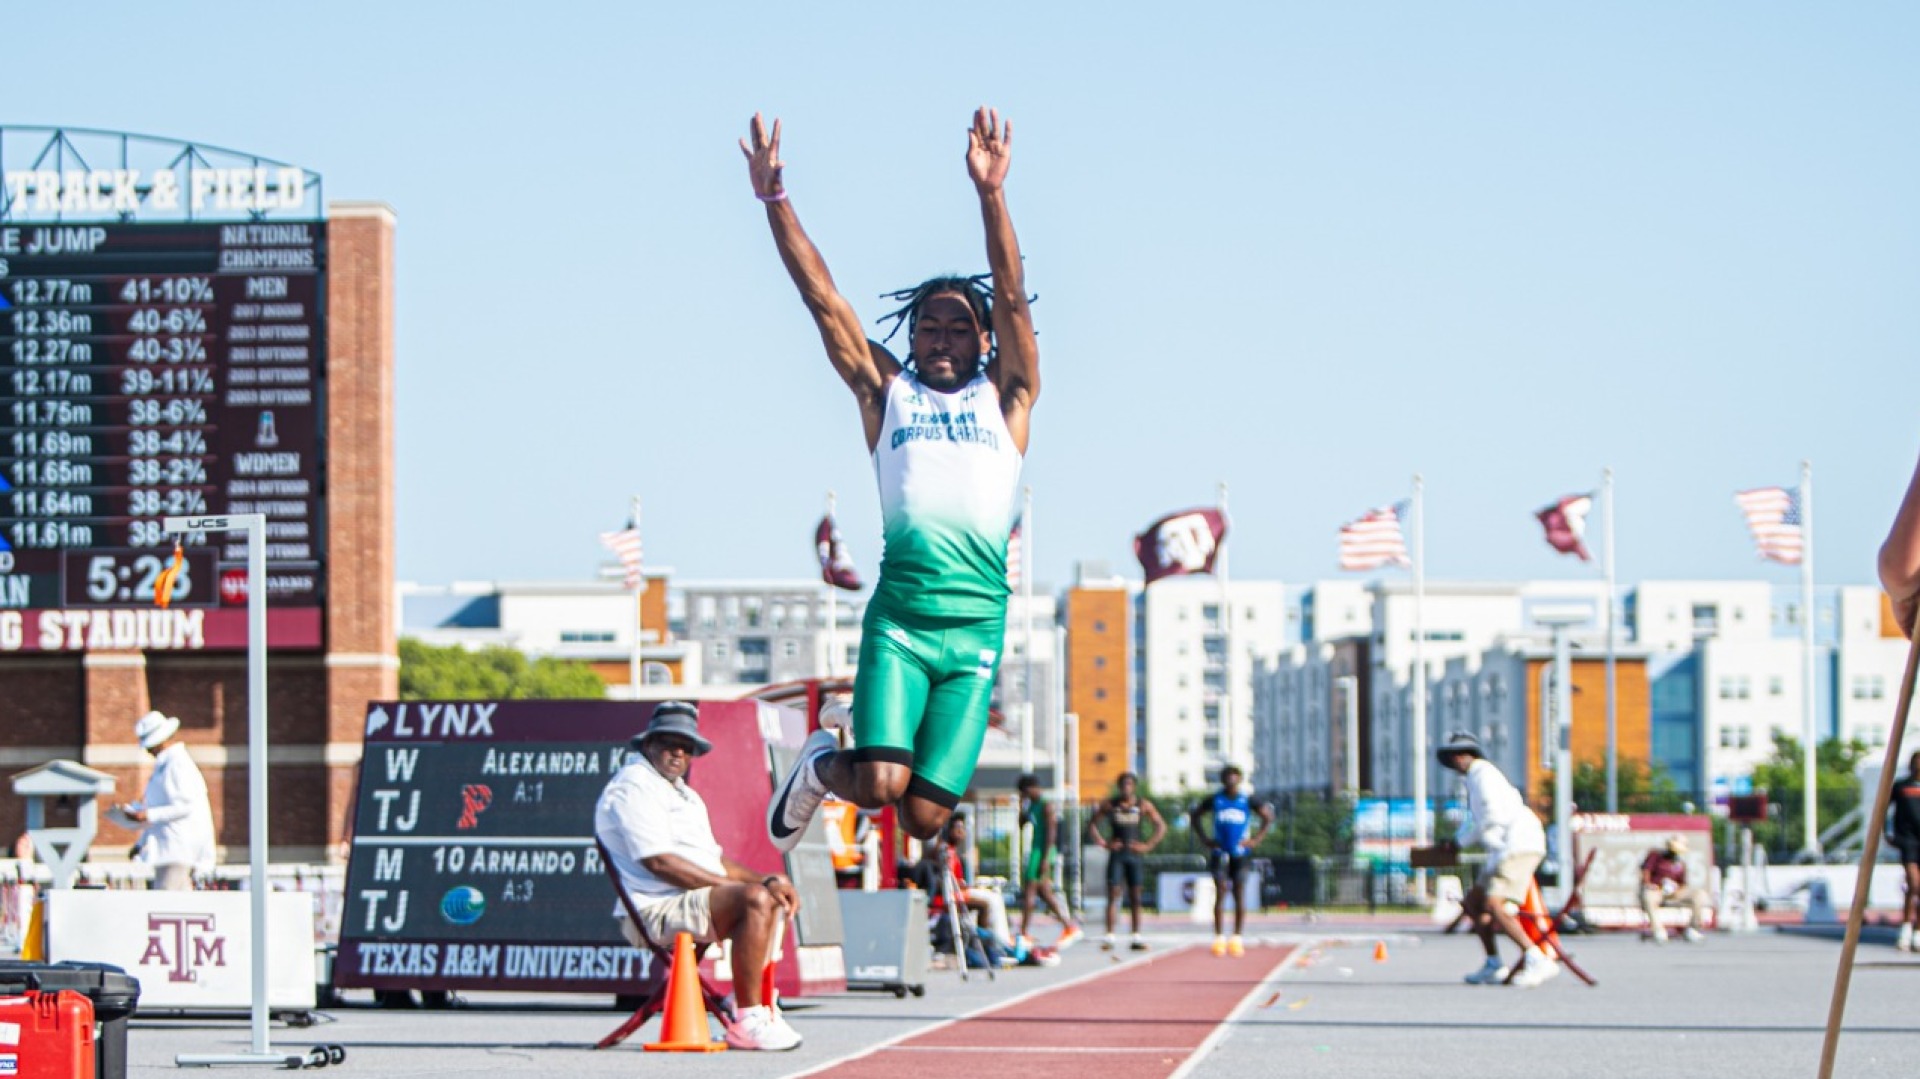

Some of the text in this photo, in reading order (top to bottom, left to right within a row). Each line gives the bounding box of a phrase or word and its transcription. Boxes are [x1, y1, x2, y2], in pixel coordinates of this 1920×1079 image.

[7, 167, 304, 212] TRACK & FIELD
[0, 227, 107, 254] E JUMP
[222, 225, 313, 244] NATIONAL
[222, 249, 314, 268] CHAMPIONS
[12, 279, 92, 303] 12.77m
[246, 277, 288, 297] MEN
[12, 310, 92, 334] 12.36m
[12, 339, 92, 364] 12.27m
[12, 369, 92, 394] 12.17m
[12, 400, 92, 425] 11.75m
[12, 430, 92, 454] 11.69m
[12, 460, 92, 485] 11.65m
[235, 453, 300, 475] WOMEN
[12, 490, 92, 515] 11.64m
[12, 521, 92, 547] 11.61m
[187, 518, 229, 529] UCS
[38, 609, 205, 650] STADIUM
[394, 703, 498, 737] LYNX
[385, 748, 419, 782] W
[482, 748, 599, 775] ALEXANDRA
[514, 781, 544, 803] A:1
[372, 789, 421, 831] TJ
[374, 848, 403, 881] M
[433, 847, 606, 874] 10 ARMANDO R
[361, 889, 409, 931] TJ
[359, 942, 653, 979] TEXAS A&M UNIVERSITY
[853, 965, 898, 979] UCS
